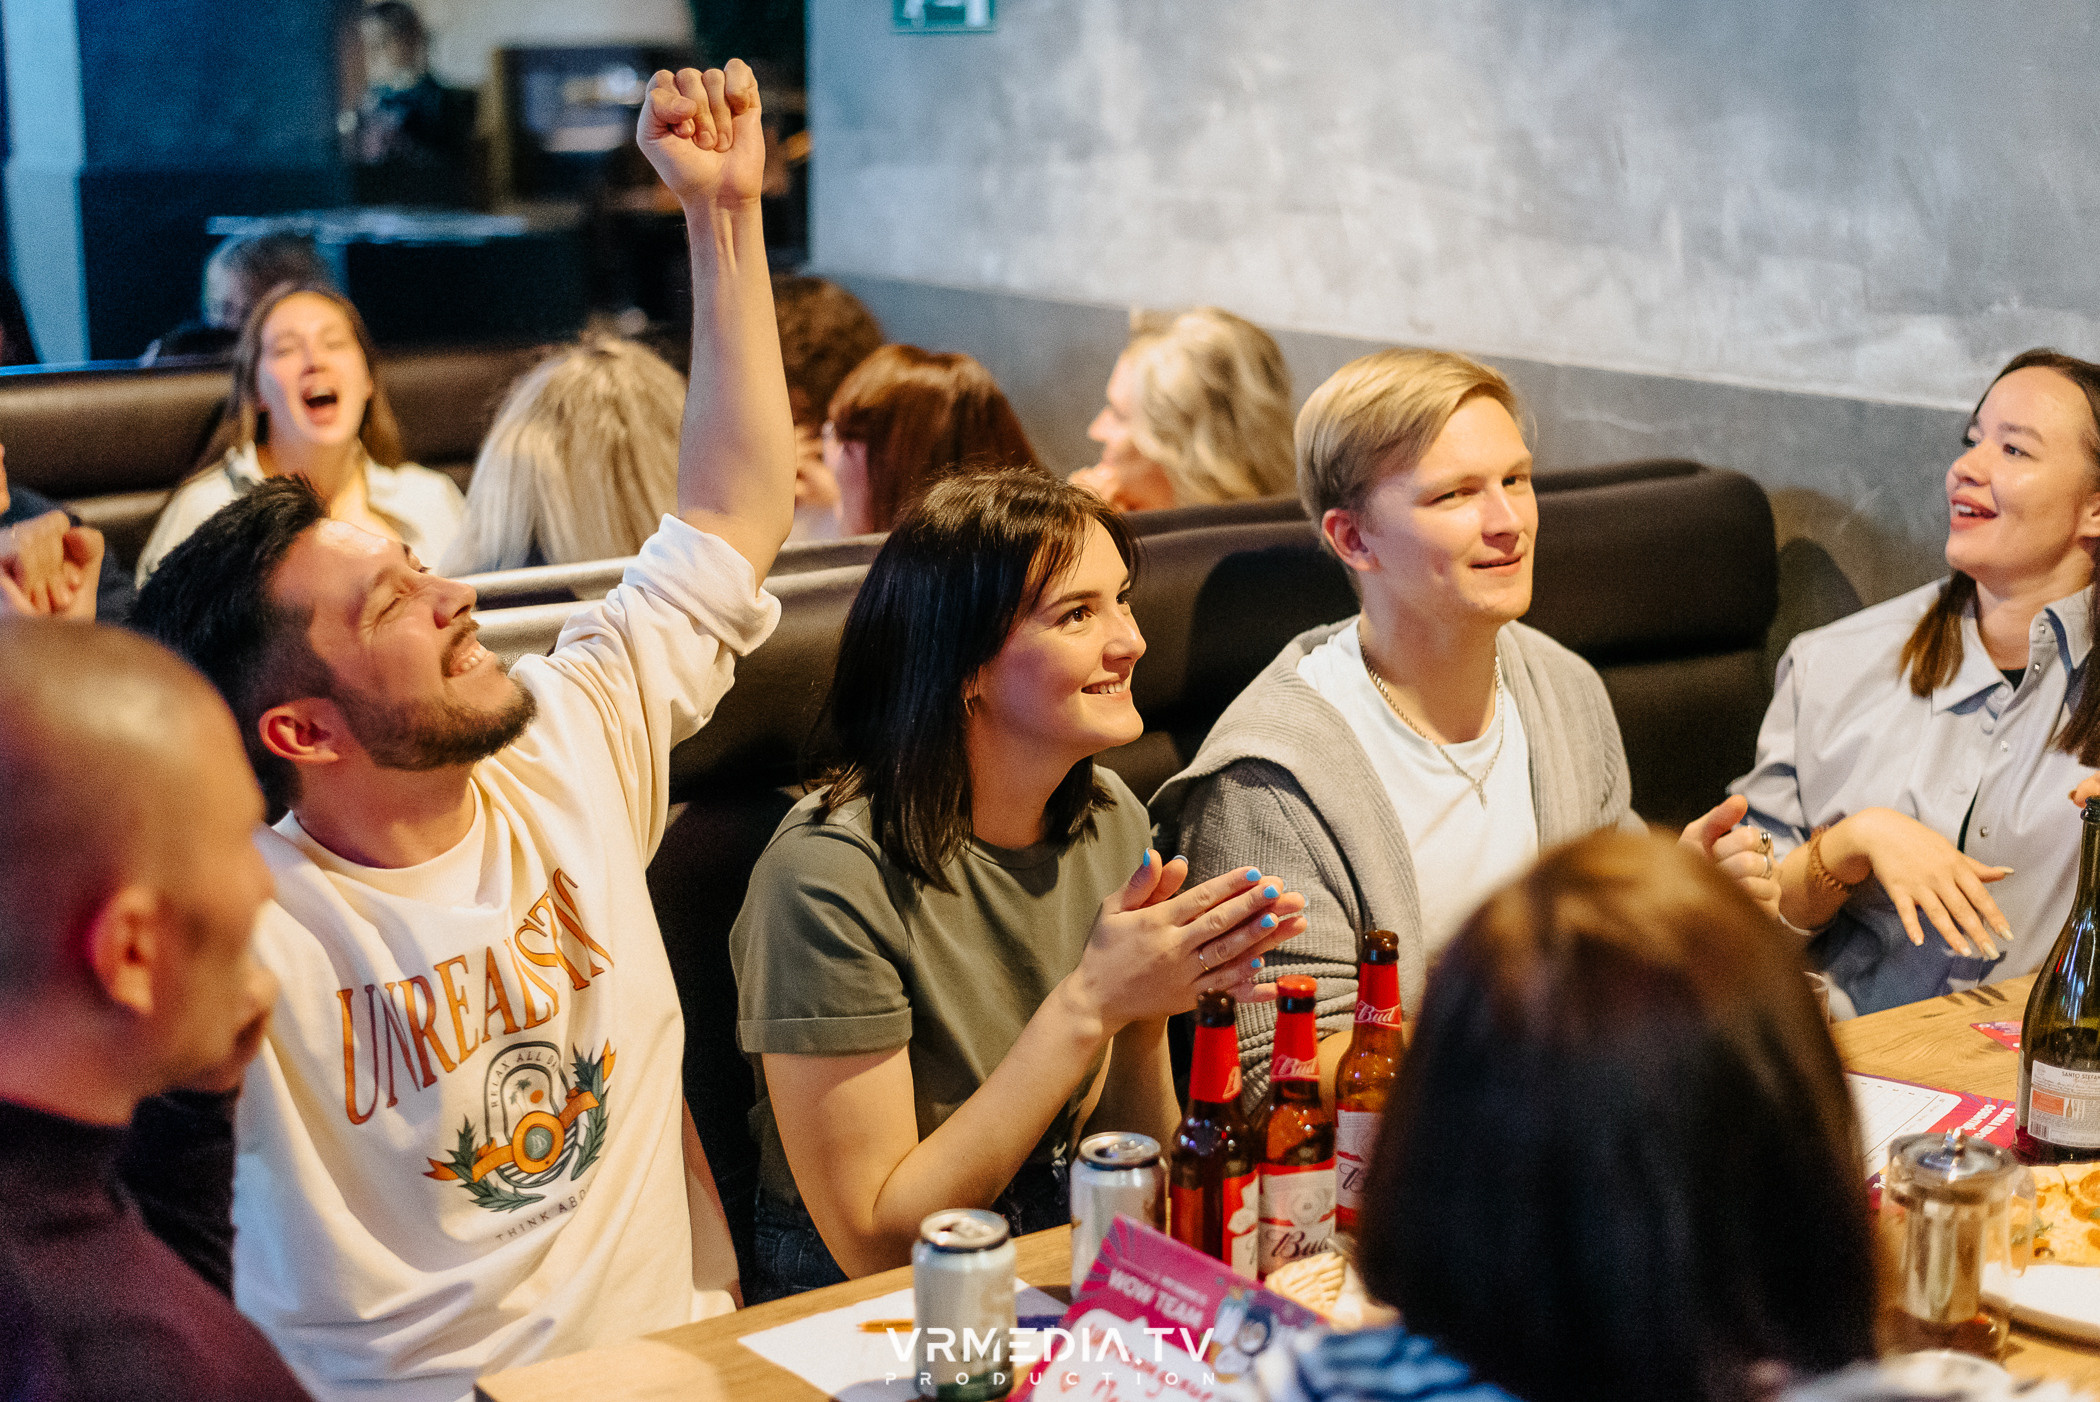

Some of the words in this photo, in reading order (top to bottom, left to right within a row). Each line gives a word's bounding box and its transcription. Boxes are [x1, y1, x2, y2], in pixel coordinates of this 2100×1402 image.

[1356, 1000, 1396, 1022] Bud
[516, 1051, 541, 1063] ALL
[1273, 1054, 1317, 1076] Bud
[2061, 1071, 2080, 1079] SANTO
[496, 1211, 549, 1240] THINK
[559, 1188, 588, 1213] ABO
[1155, 1290, 1203, 1328] TEAM
